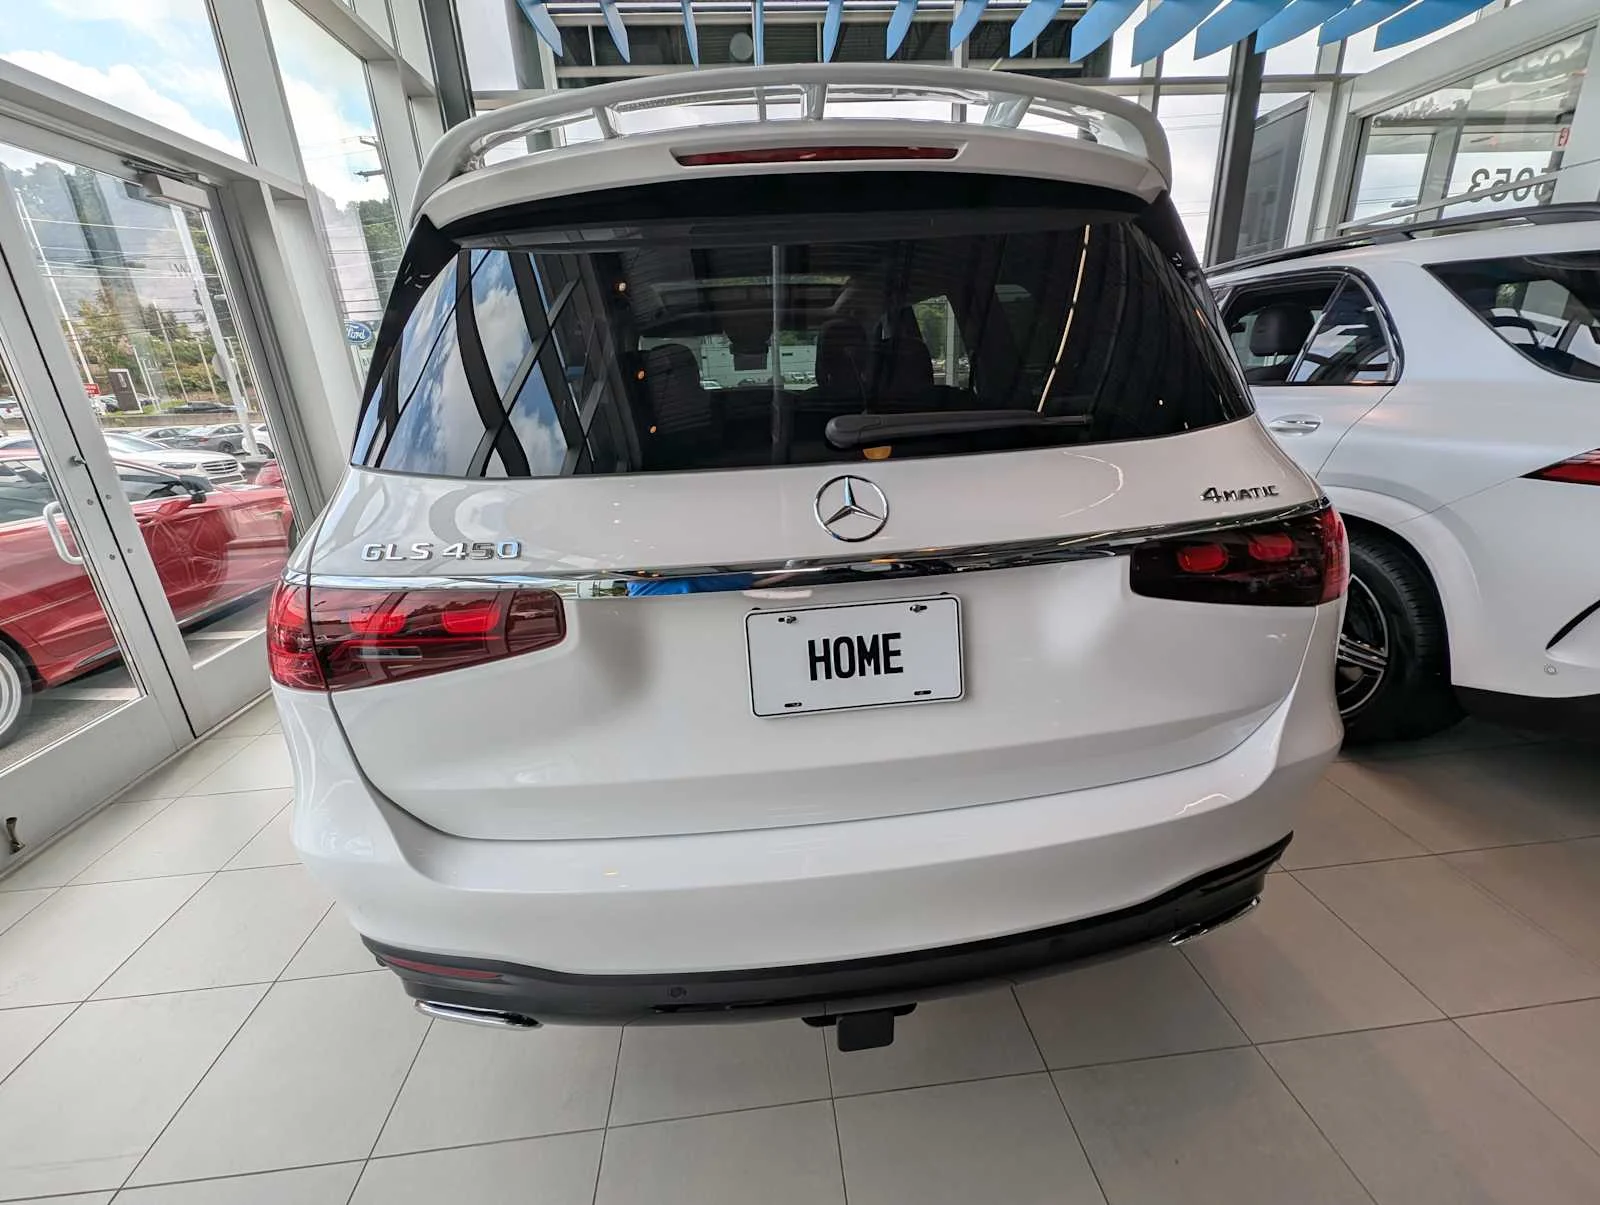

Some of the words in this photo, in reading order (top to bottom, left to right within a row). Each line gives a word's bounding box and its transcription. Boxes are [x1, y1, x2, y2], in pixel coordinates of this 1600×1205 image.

[1200, 485, 1279, 503] 4MATIC
[361, 542, 433, 561] GLS
[442, 539, 522, 560] 450
[807, 632, 904, 681] HOME
